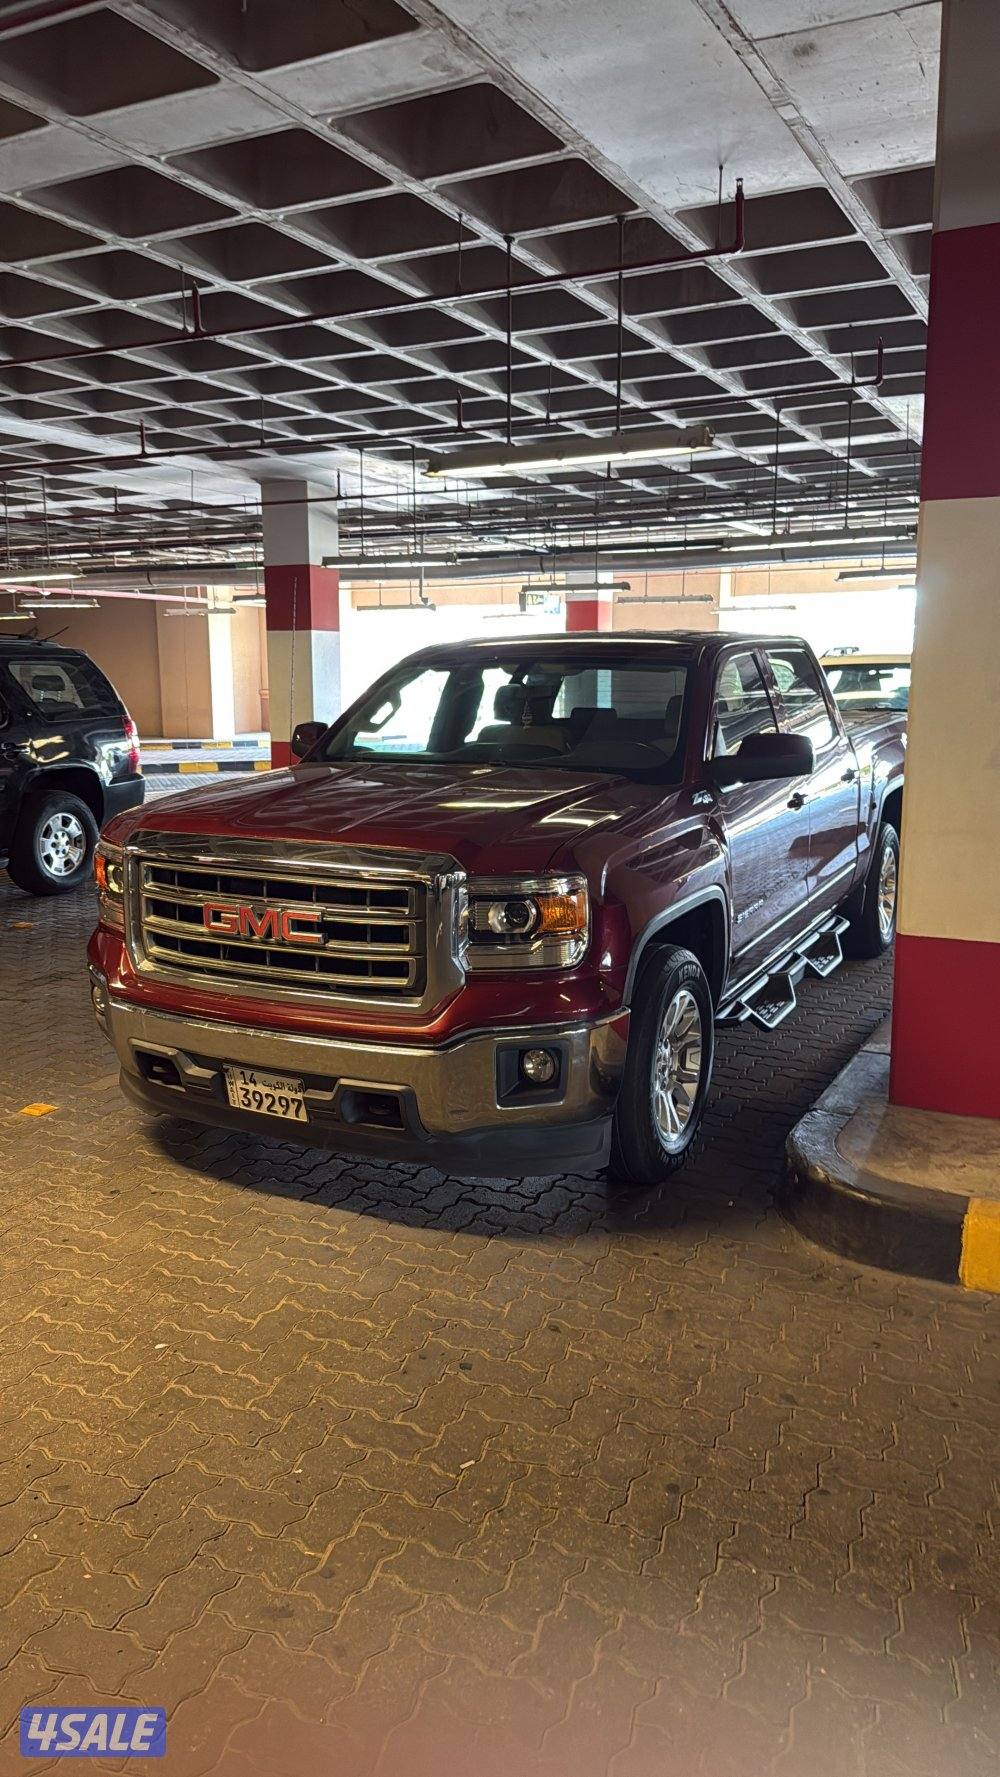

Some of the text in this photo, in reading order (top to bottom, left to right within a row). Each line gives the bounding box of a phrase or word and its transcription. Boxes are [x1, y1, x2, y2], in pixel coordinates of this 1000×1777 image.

[203, 902, 325, 944] GMC
[678, 964, 700, 984] KENDA
[240, 1071, 256, 1087] 14
[240, 1087, 302, 1118] 39297
